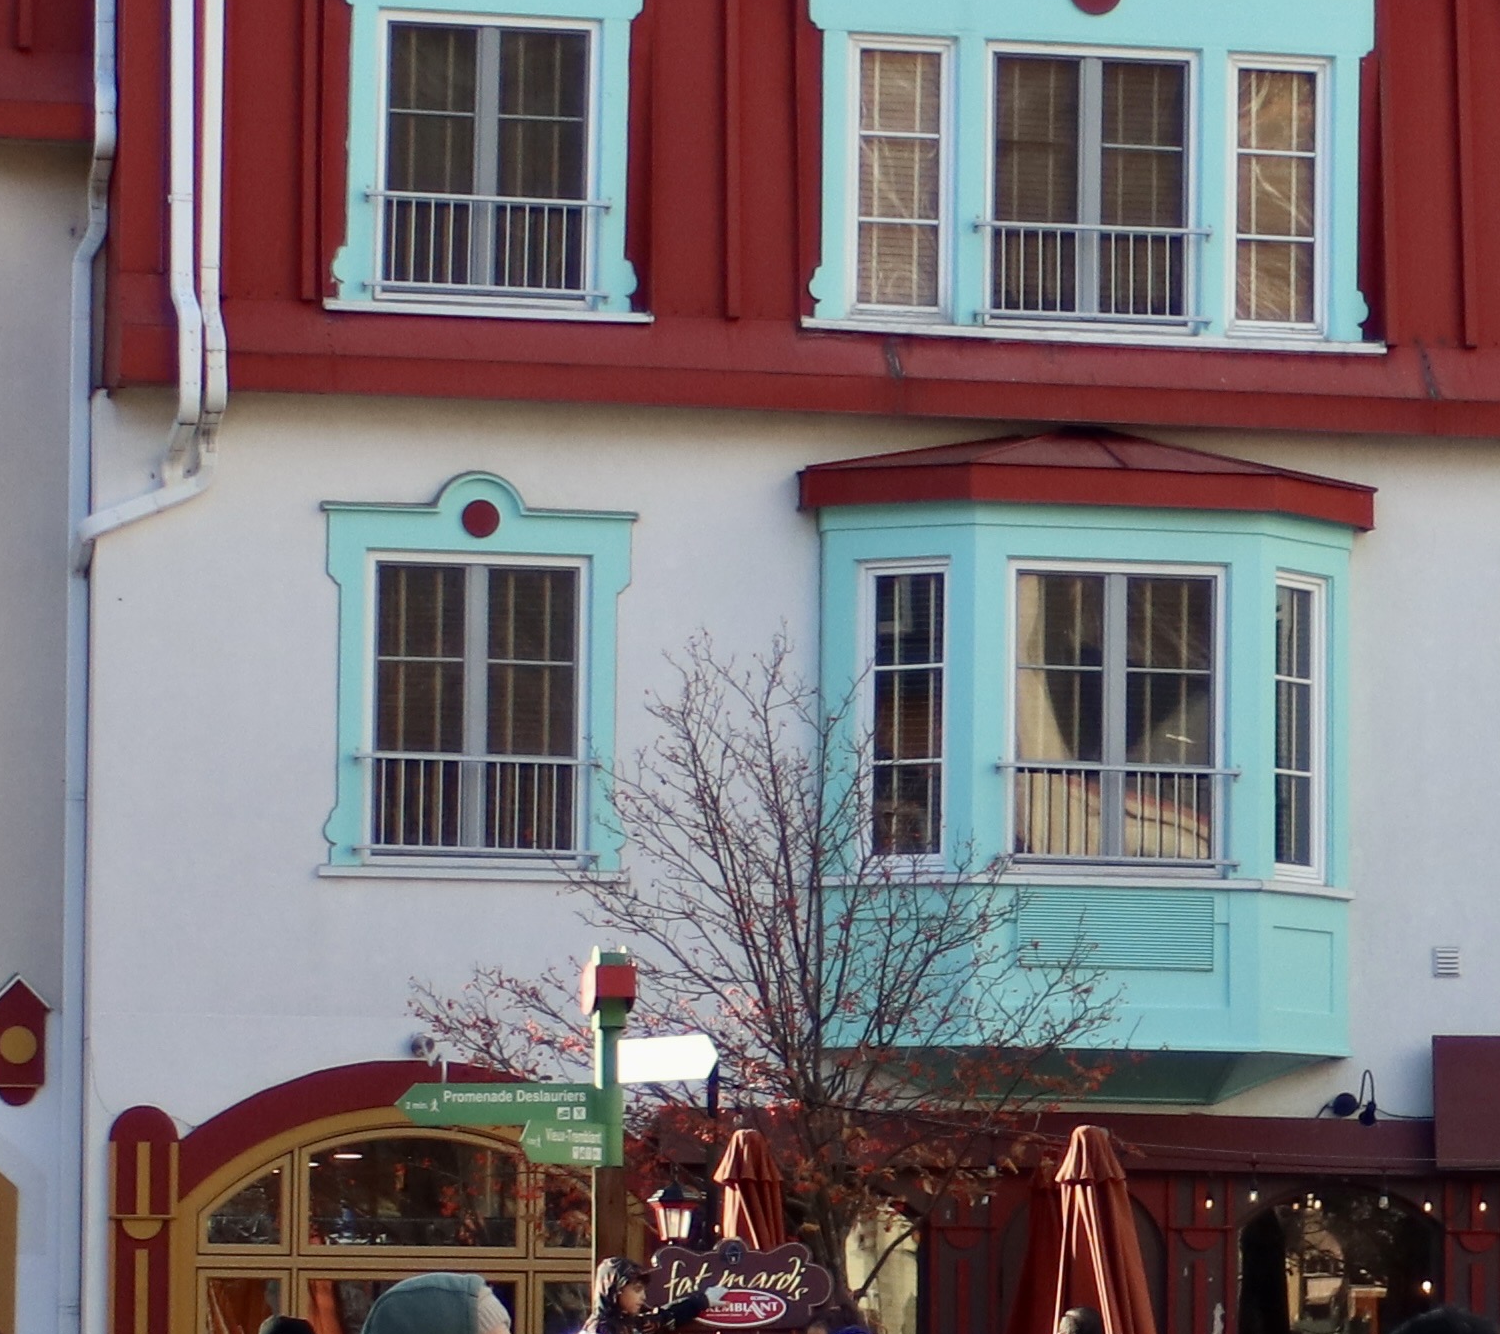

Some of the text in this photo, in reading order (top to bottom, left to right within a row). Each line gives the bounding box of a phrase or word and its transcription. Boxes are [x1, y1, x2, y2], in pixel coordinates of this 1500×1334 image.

[443, 1089, 587, 1103] Promenade Deslauriers
[663, 1255, 809, 1304] fat mardis
